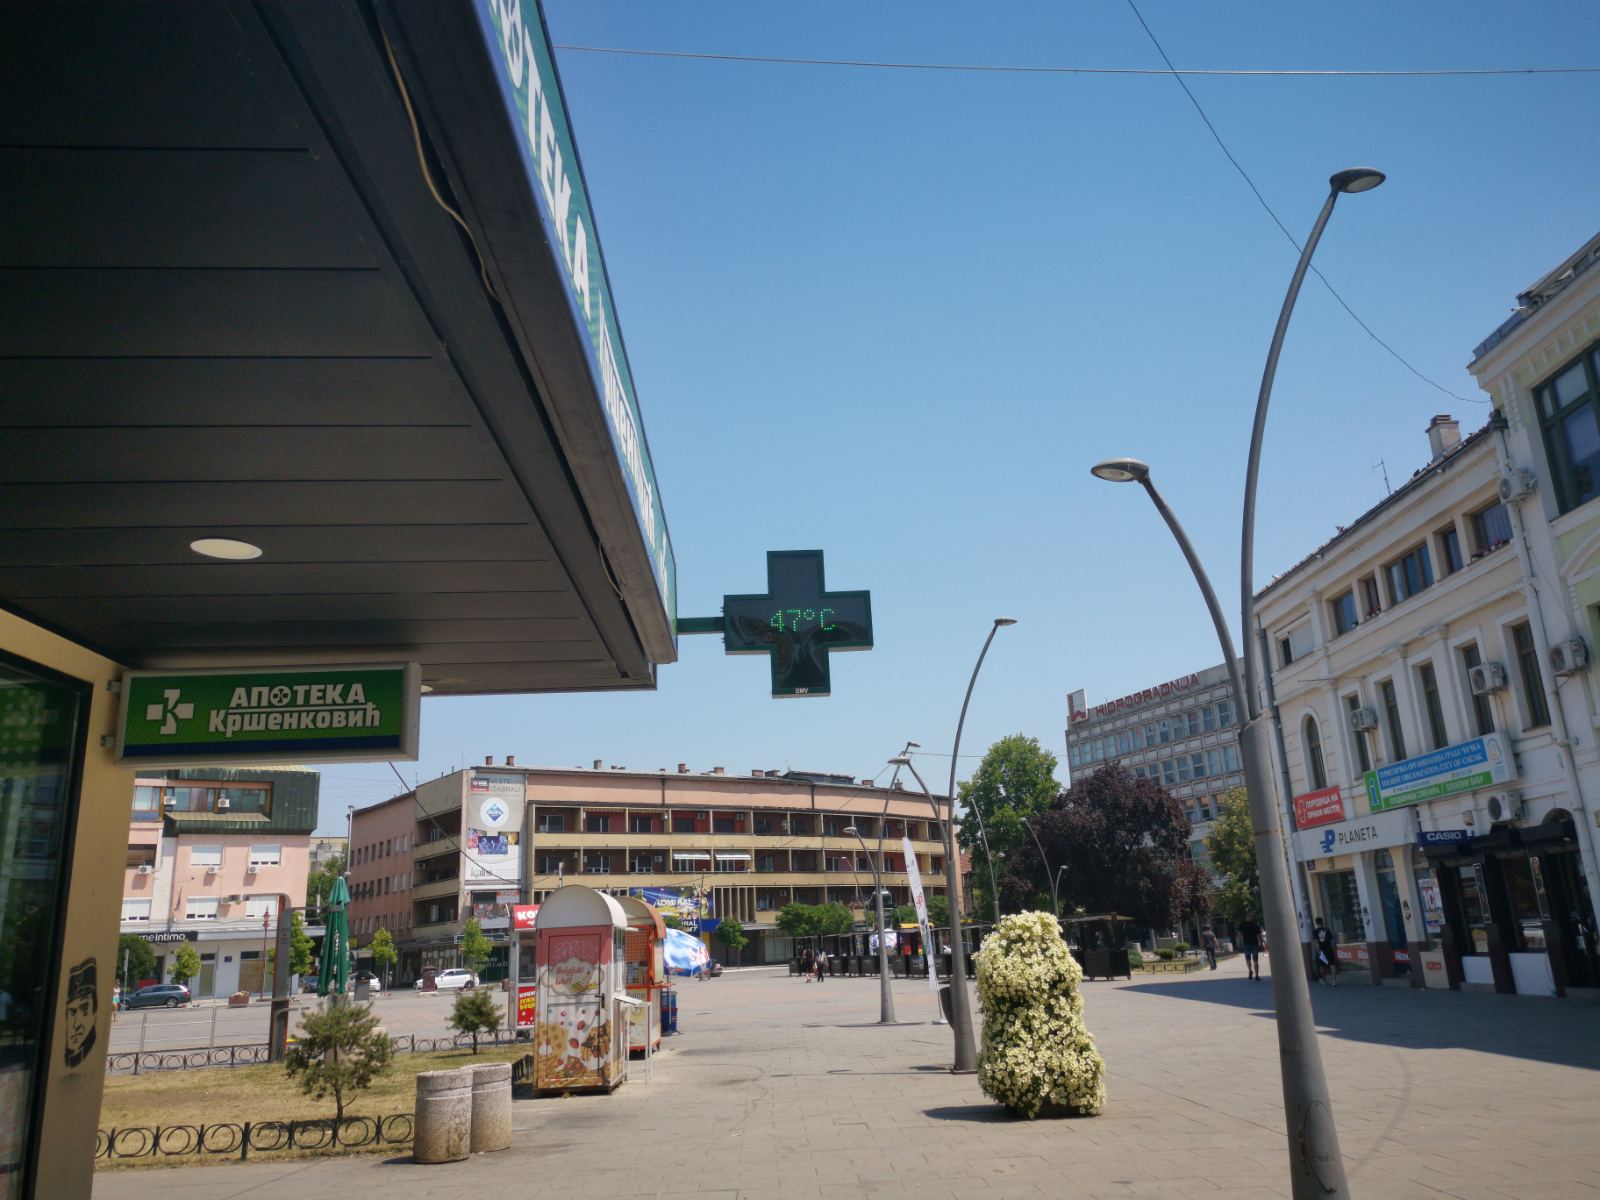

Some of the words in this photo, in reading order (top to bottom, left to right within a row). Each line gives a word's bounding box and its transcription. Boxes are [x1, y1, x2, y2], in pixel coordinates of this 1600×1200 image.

[229, 682, 366, 709] АПОТЕКА
[208, 700, 381, 737] Кршенковић
[1338, 825, 1378, 845] PLANETA
[1426, 831, 1462, 841] CASIO
